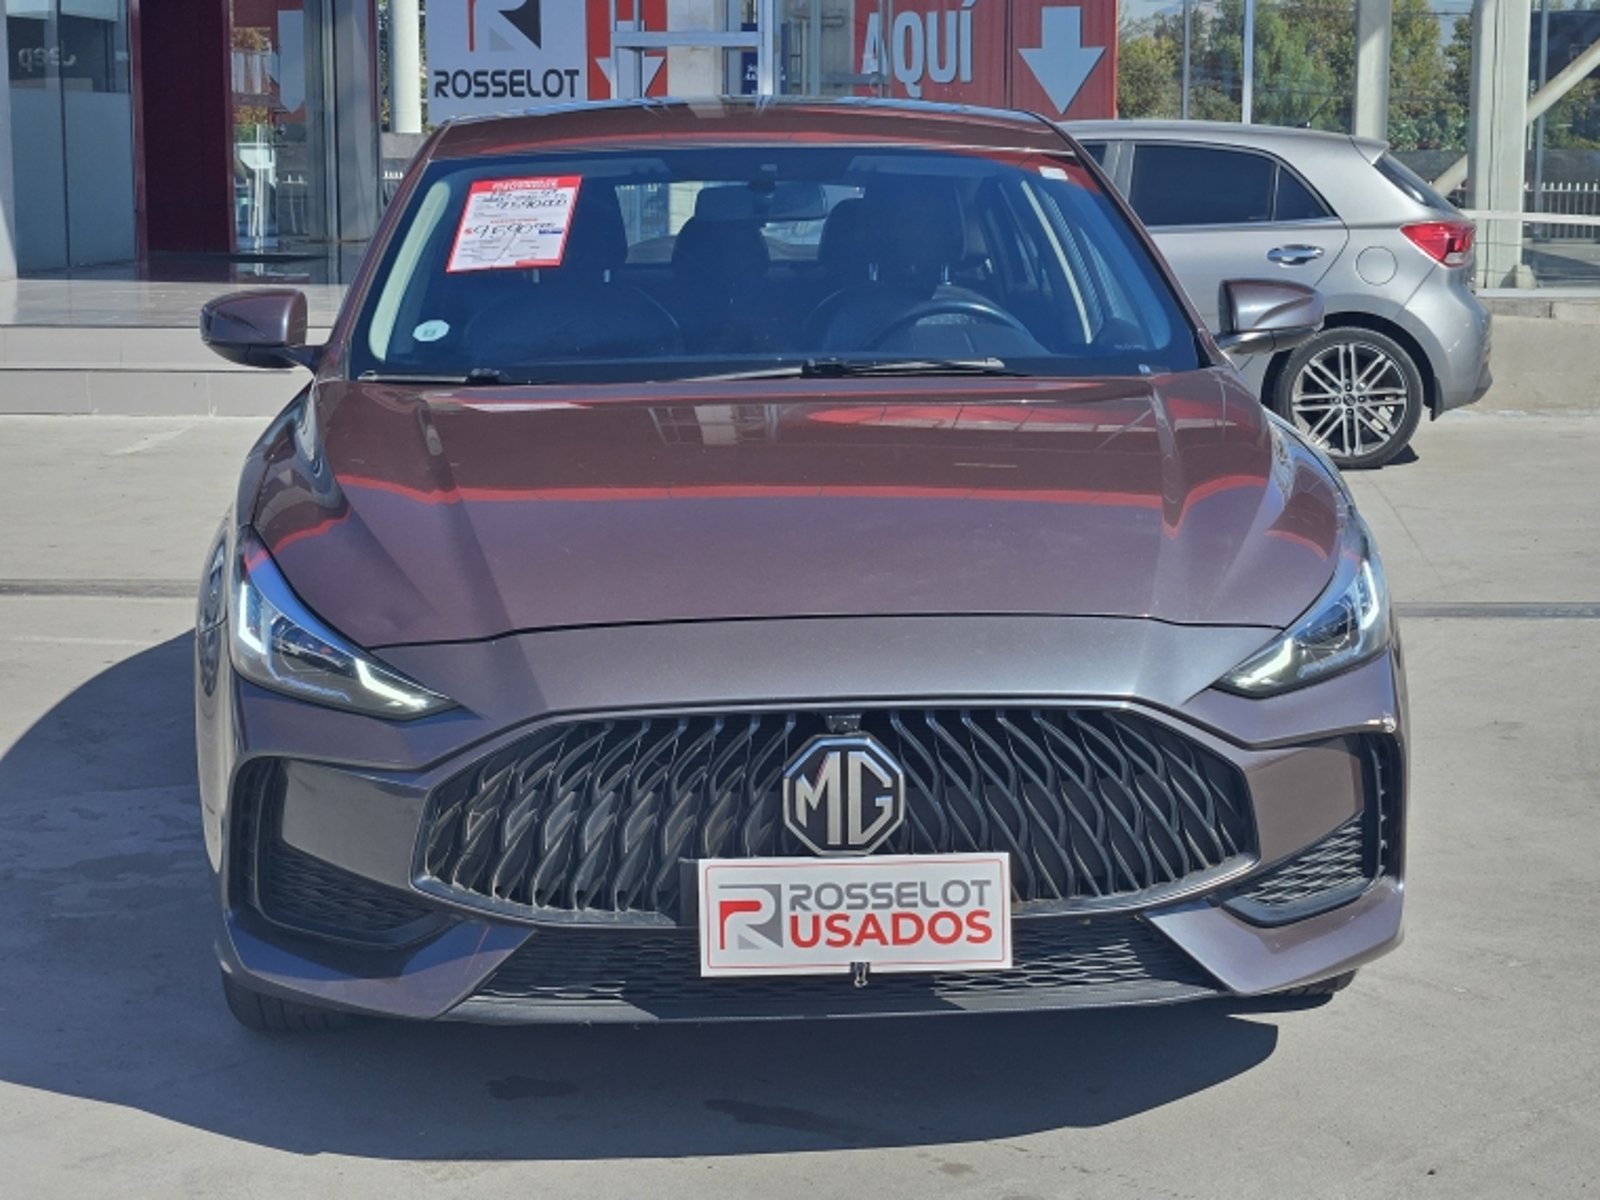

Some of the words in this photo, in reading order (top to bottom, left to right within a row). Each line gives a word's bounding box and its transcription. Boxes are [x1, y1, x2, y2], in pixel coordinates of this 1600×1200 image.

[861, 0, 976, 97] AQUÍ
[434, 69, 580, 98] ROSSELOT
[796, 751, 893, 845] MG
[789, 879, 992, 911] ROSSELOT
[790, 909, 993, 949] USADOS
